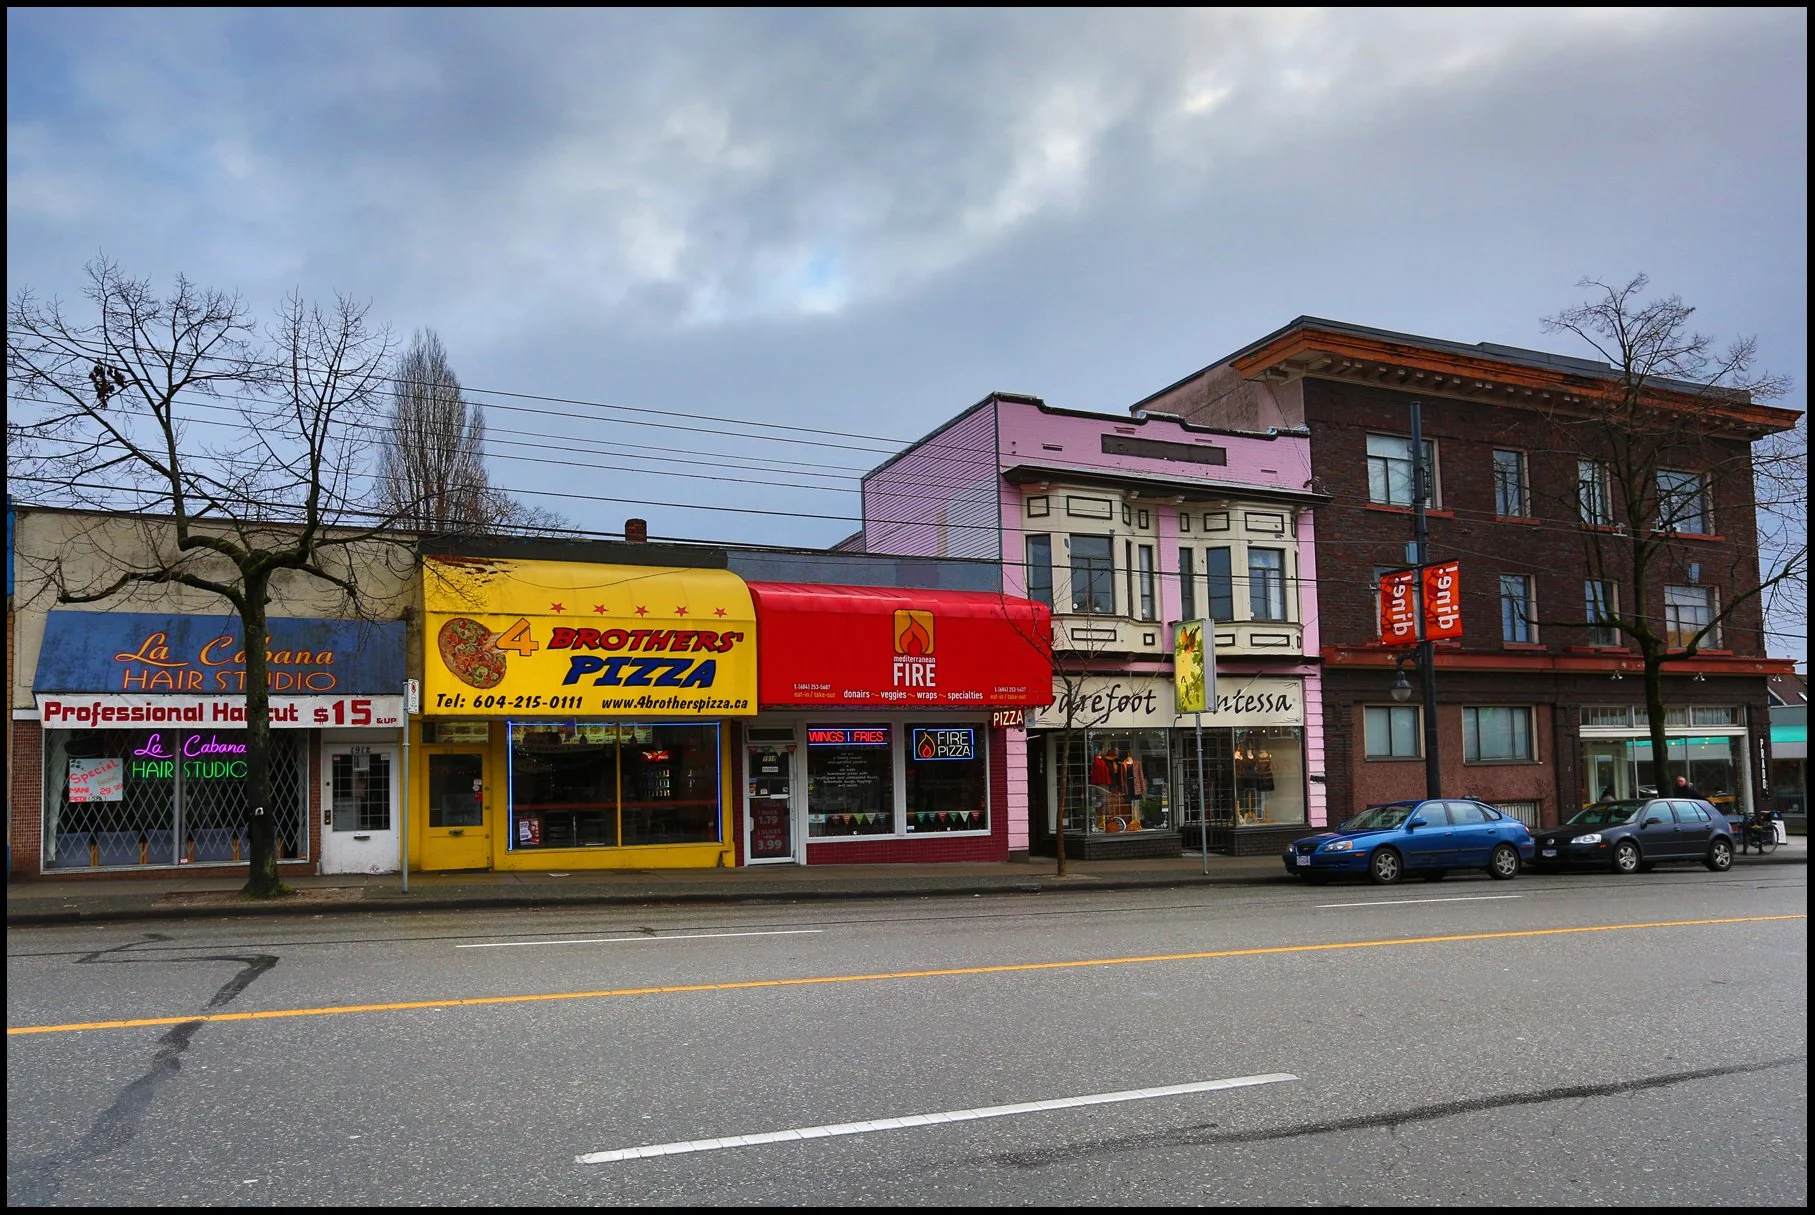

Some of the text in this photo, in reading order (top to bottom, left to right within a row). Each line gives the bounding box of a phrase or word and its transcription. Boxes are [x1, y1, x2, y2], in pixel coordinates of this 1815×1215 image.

[495, 617, 744, 656] 4 BROTHERS'
[115, 632, 189, 667] La
[893, 655, 936, 663] mediterranean
[123, 669, 202, 690] HAIR
[562, 655, 717, 688] PIZZA
[893, 663, 936, 687] FIRE
[436, 693, 466, 709] Tel:
[473, 695, 583, 709] 604-215-0111
[602, 695, 748, 713] www.4brotherspizza.ca
[843, 690, 984, 700] donairs veggies wraps specialties
[1217, 689, 1293, 713] ntessa
[44, 701, 204, 727] Professional
[313, 700, 372, 725] $15
[993, 710, 1024, 727] PIZZA
[808, 731, 884, 742] WINGS FRIES
[937, 731, 969, 746] FIRE
[133, 733, 247, 758] La Cabana
[350, 746, 372, 754] 1912
[937, 745, 971, 757] PIZZA
[132, 761, 174, 778] HAIR
[758, 815, 778, 824] 1.79
[757, 839, 783, 850] 3.99
